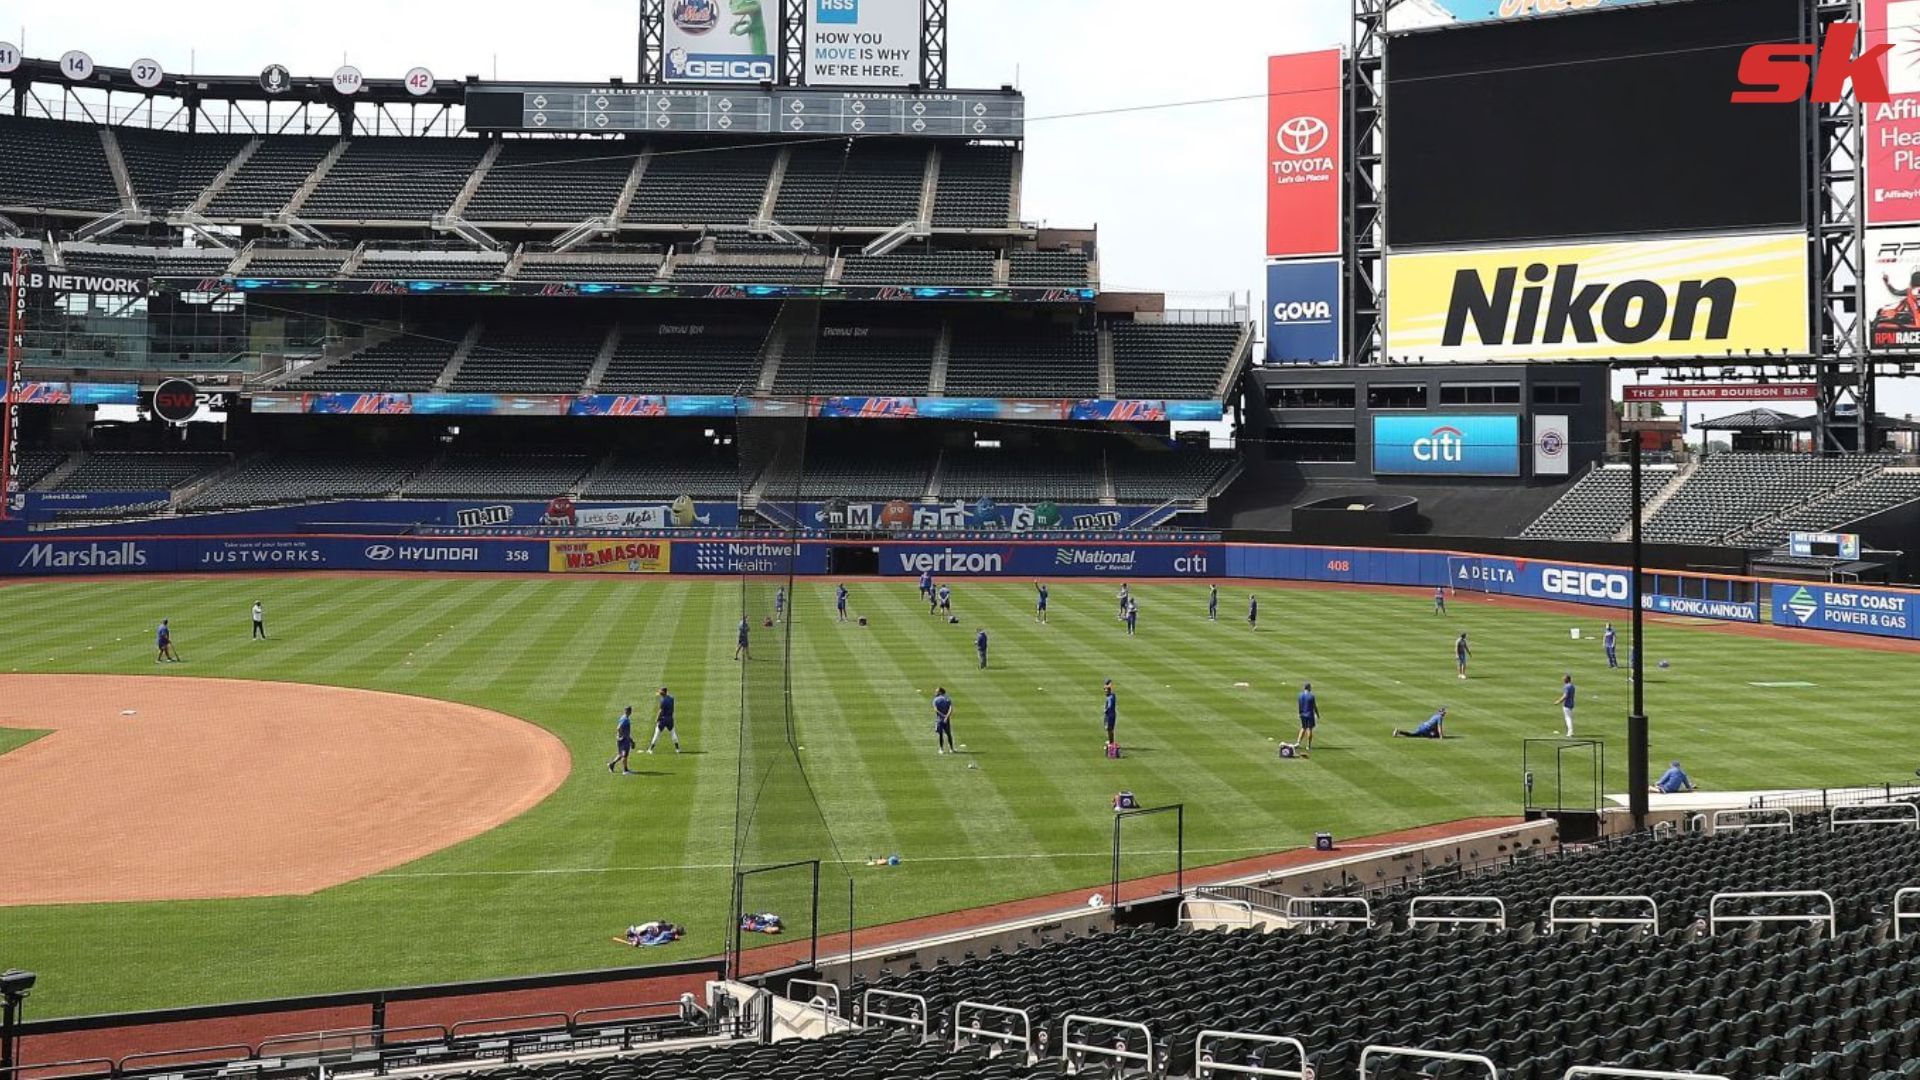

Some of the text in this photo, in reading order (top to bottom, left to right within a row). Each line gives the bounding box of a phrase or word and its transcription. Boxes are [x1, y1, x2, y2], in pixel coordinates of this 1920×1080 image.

[816, 33, 882, 44] HOW YOU
[816, 48, 910, 60] MOVE IS WHY
[69, 58, 84, 72] 14
[815, 64, 904, 77] WE'RE HERE.
[137, 66, 157, 80] 37
[336, 75, 359, 85] SHEA
[410, 75, 428, 87] 42
[1272, 157, 1334, 174] TOYOTA
[2, 271, 141, 293] MB NETWORK
[1274, 301, 1332, 321] GOYA
[1441, 263, 1737, 346] Nikon
[1632, 387, 1808, 397] THE JIM BEAM BOURBON BAR
[1413, 433, 1461, 461] citi
[18, 542, 147, 567] Marshalls
[399, 547, 478, 560] HYUNDAI
[506, 550, 529, 561] 358
[728, 544, 800, 556] Northwell
[1073, 550, 1135, 563] National
[728, 559, 773, 571] Health
[900, 548, 1002, 572] verizon
[1327, 560, 1349, 571] 408
[1472, 566, 1515, 583] DELTA
[1542, 568, 1628, 600] GEICO
[1824, 592, 1905, 611] EAST COAST
[1671, 600, 1754, 619] KONICA MINOLTA
[1824, 610, 1906, 628] POWER & GAS
